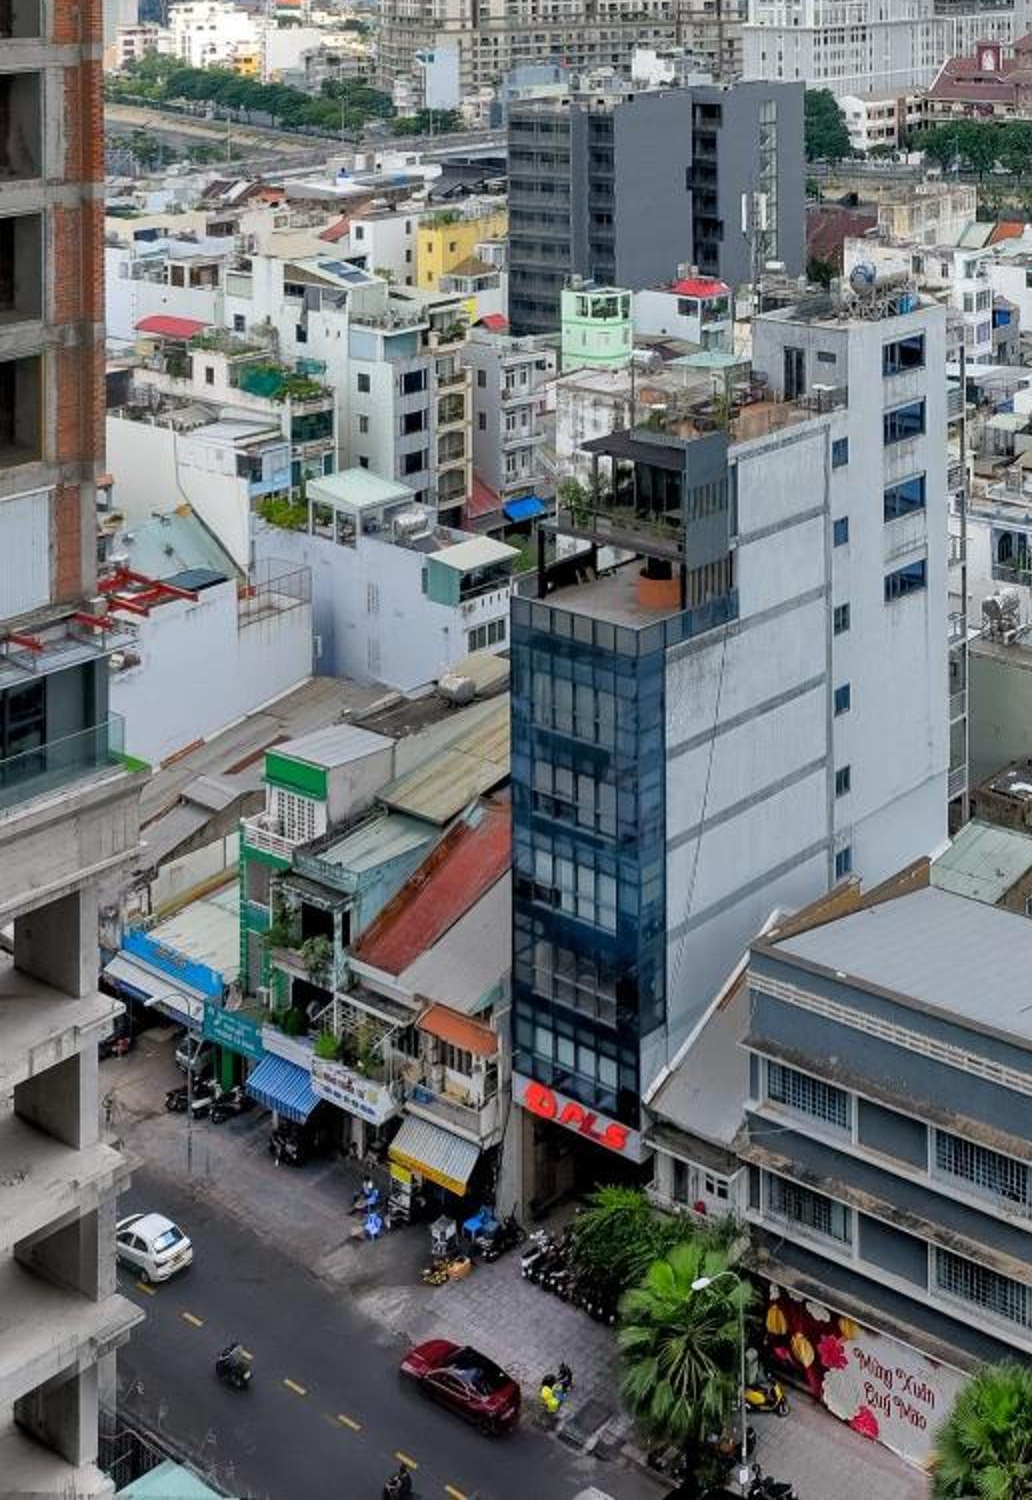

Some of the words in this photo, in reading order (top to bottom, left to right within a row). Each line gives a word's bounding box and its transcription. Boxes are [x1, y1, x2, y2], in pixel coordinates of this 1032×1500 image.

[854, 1347, 893, 1391] Mừng
[896, 1367, 935, 1410] Xuân
[864, 1381, 891, 1418] Quý
[893, 1395, 927, 1430] Mão
